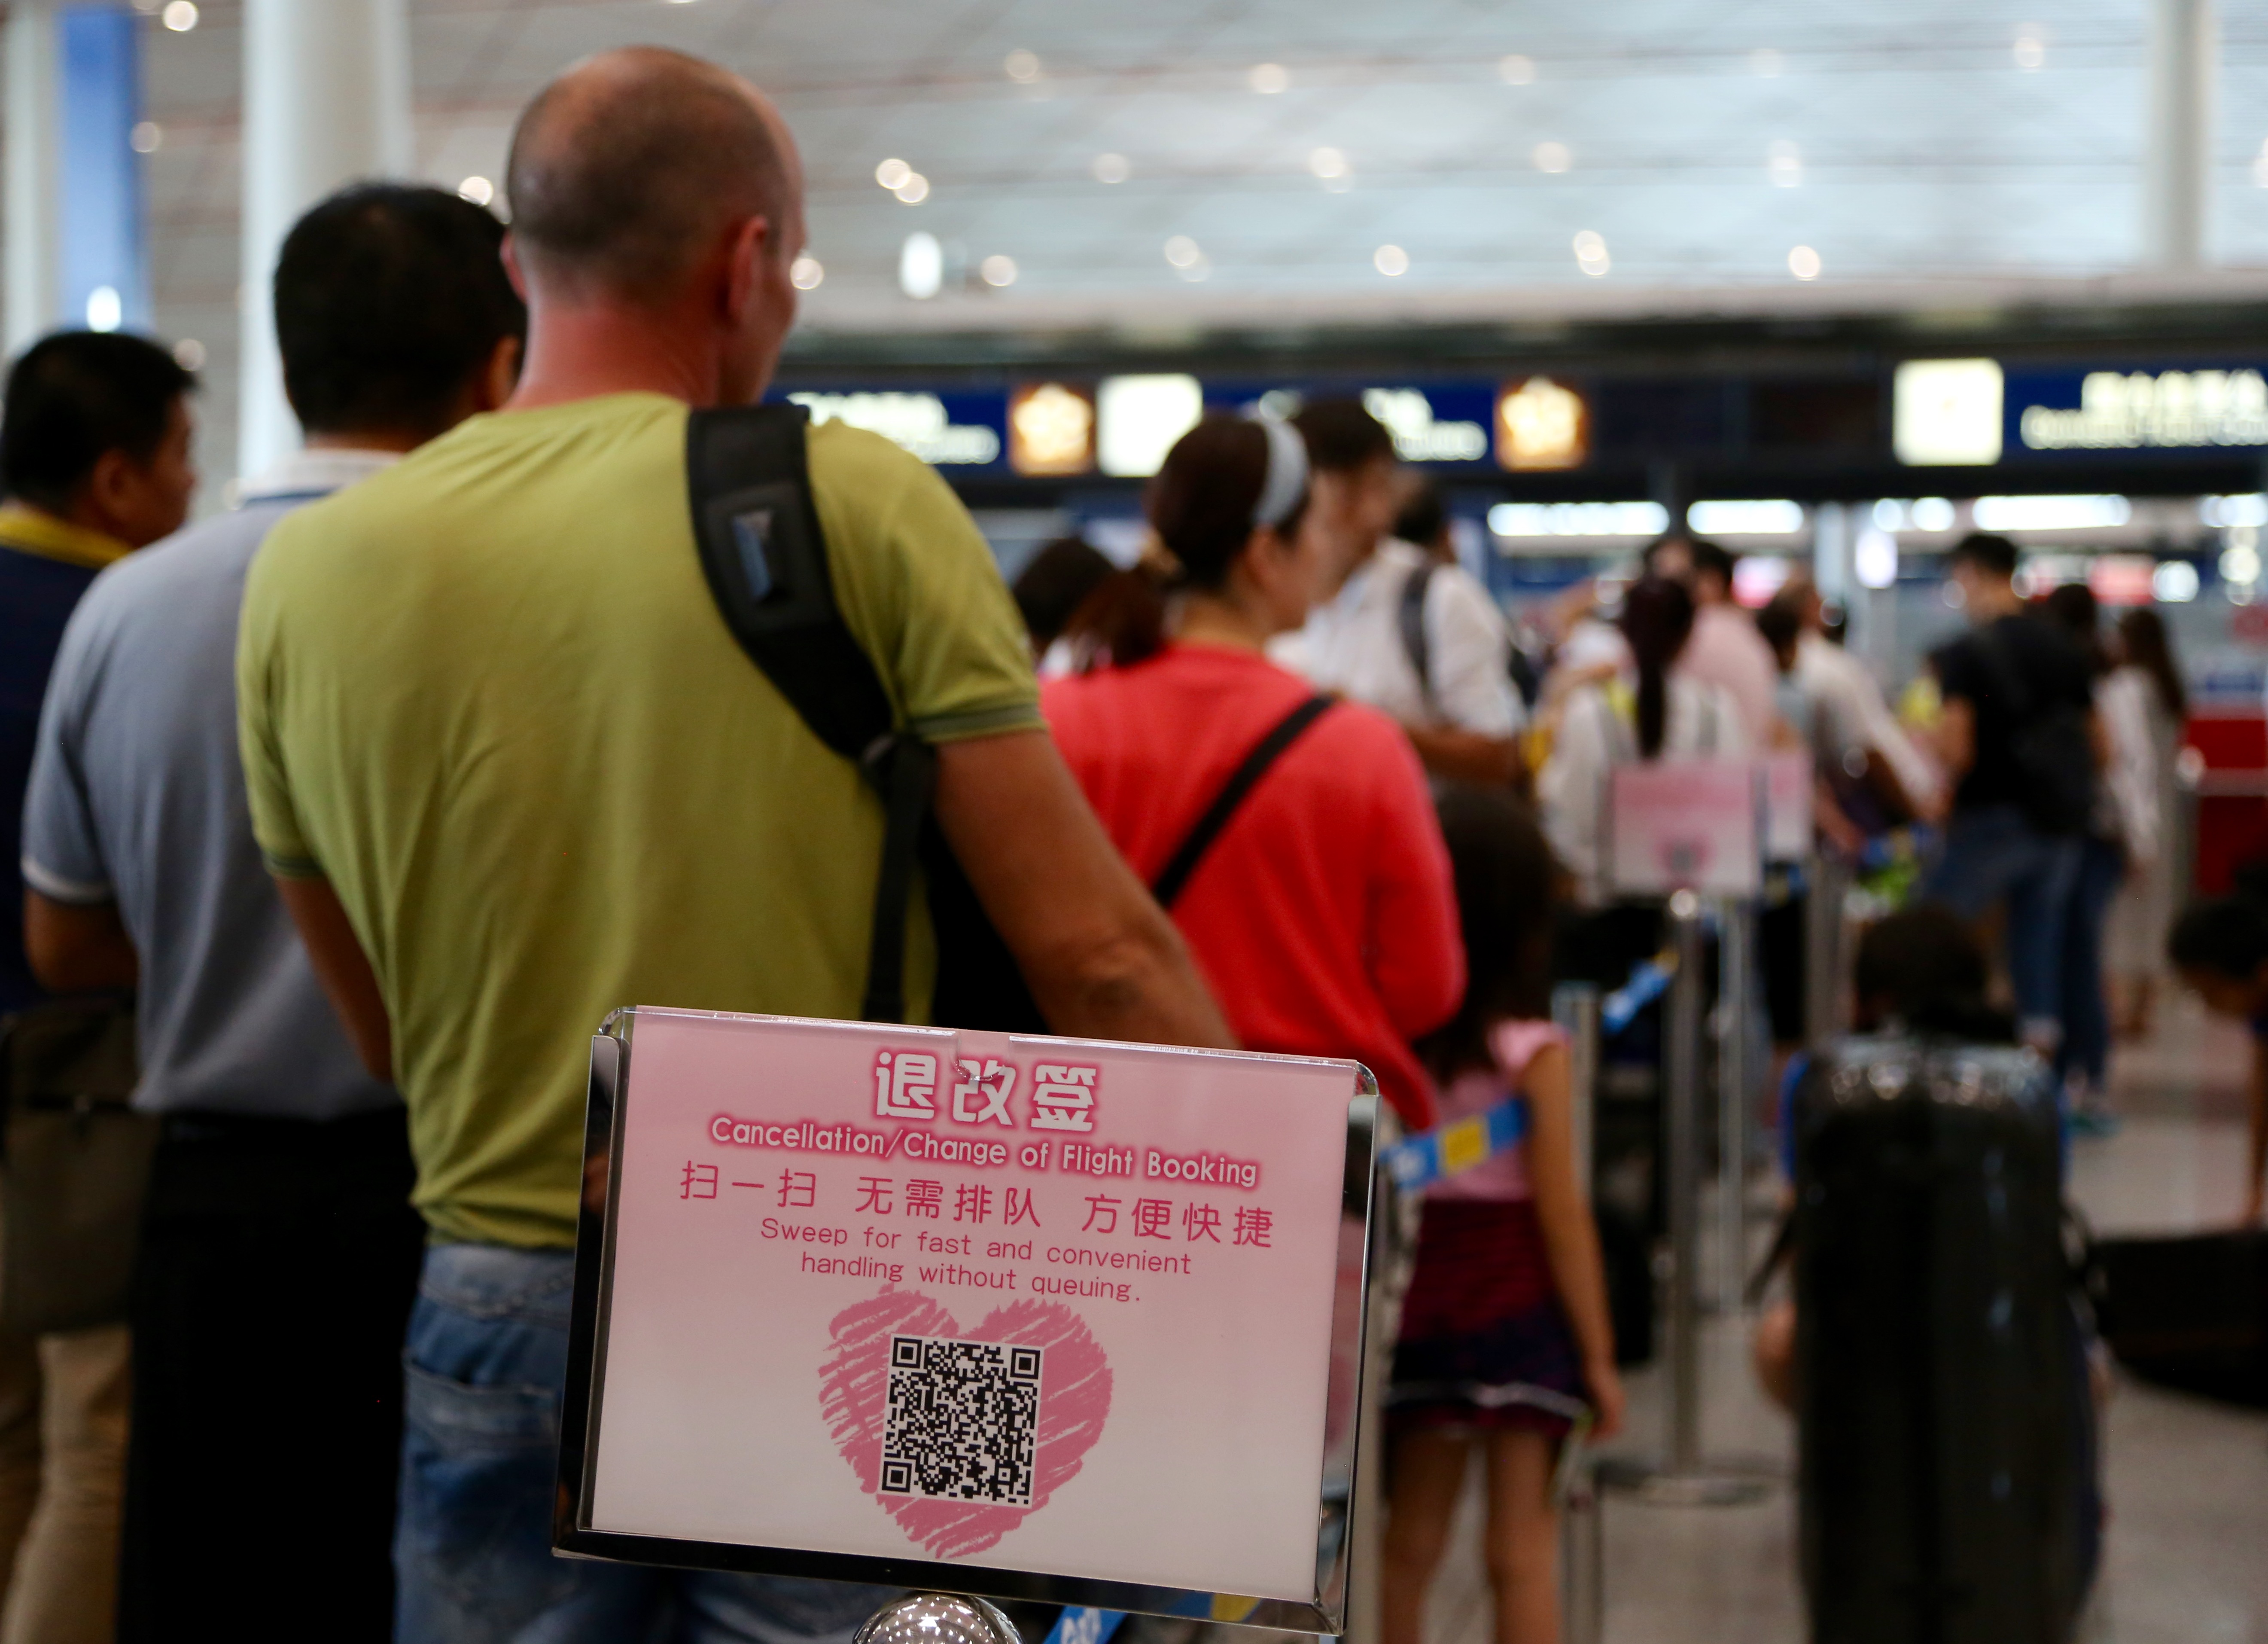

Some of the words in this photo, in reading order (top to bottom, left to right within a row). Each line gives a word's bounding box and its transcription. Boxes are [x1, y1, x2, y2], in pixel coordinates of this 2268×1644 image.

[876, 1051, 1096, 1132] 退改签
[712, 1117, 1007, 1165] Cancellation/Change
[1021, 1142, 1049, 1168] of
[1062, 1144, 1133, 1175] Flight
[1148, 1151, 1257, 1188] Booking
[680, 1160, 816, 1208] 扫一扫
[855, 1176, 1041, 1228] 无需排队
[1082, 1194, 1273, 1247] 方便快捷
[761, 1217, 848, 1247] Sweep
[863, 1226, 902, 1249] for
[917, 1231, 971, 1255] fast
[987, 1240, 1032, 1260] and
[1047, 1247, 1191, 1275] convenient
[801, 1251, 904, 1282] handling
[919, 1263, 1017, 1290] without
[1031, 1276, 1140, 1302] queuing.
